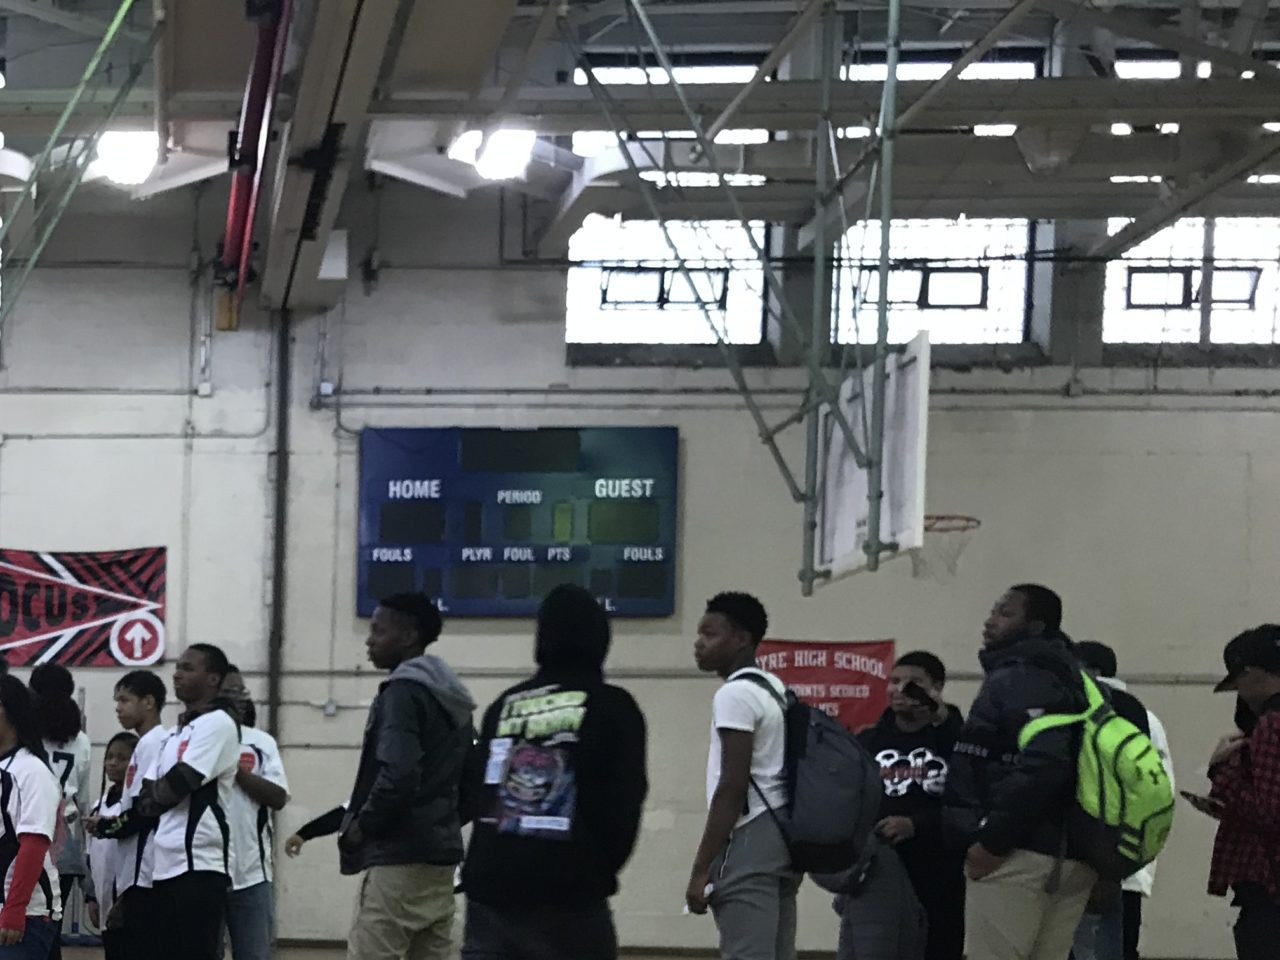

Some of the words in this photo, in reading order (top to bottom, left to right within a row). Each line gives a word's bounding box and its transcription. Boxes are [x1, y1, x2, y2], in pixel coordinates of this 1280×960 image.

[388, 479, 441, 499] HOME
[594, 478, 655, 498] GUEST
[497, 490, 542, 504] PERIOD
[372, 548, 413, 562] FOULS
[461, 547, 493, 562] PLYR
[503, 547, 535, 562] FOUL
[547, 547, 571, 562] PTS
[623, 547, 664, 562] FOULS
[755, 652, 787, 671] YRE
[794, 650, 827, 667] HIGH
[834, 651, 887, 680] SCHOOL
[52, 750, 75, 791] 7
